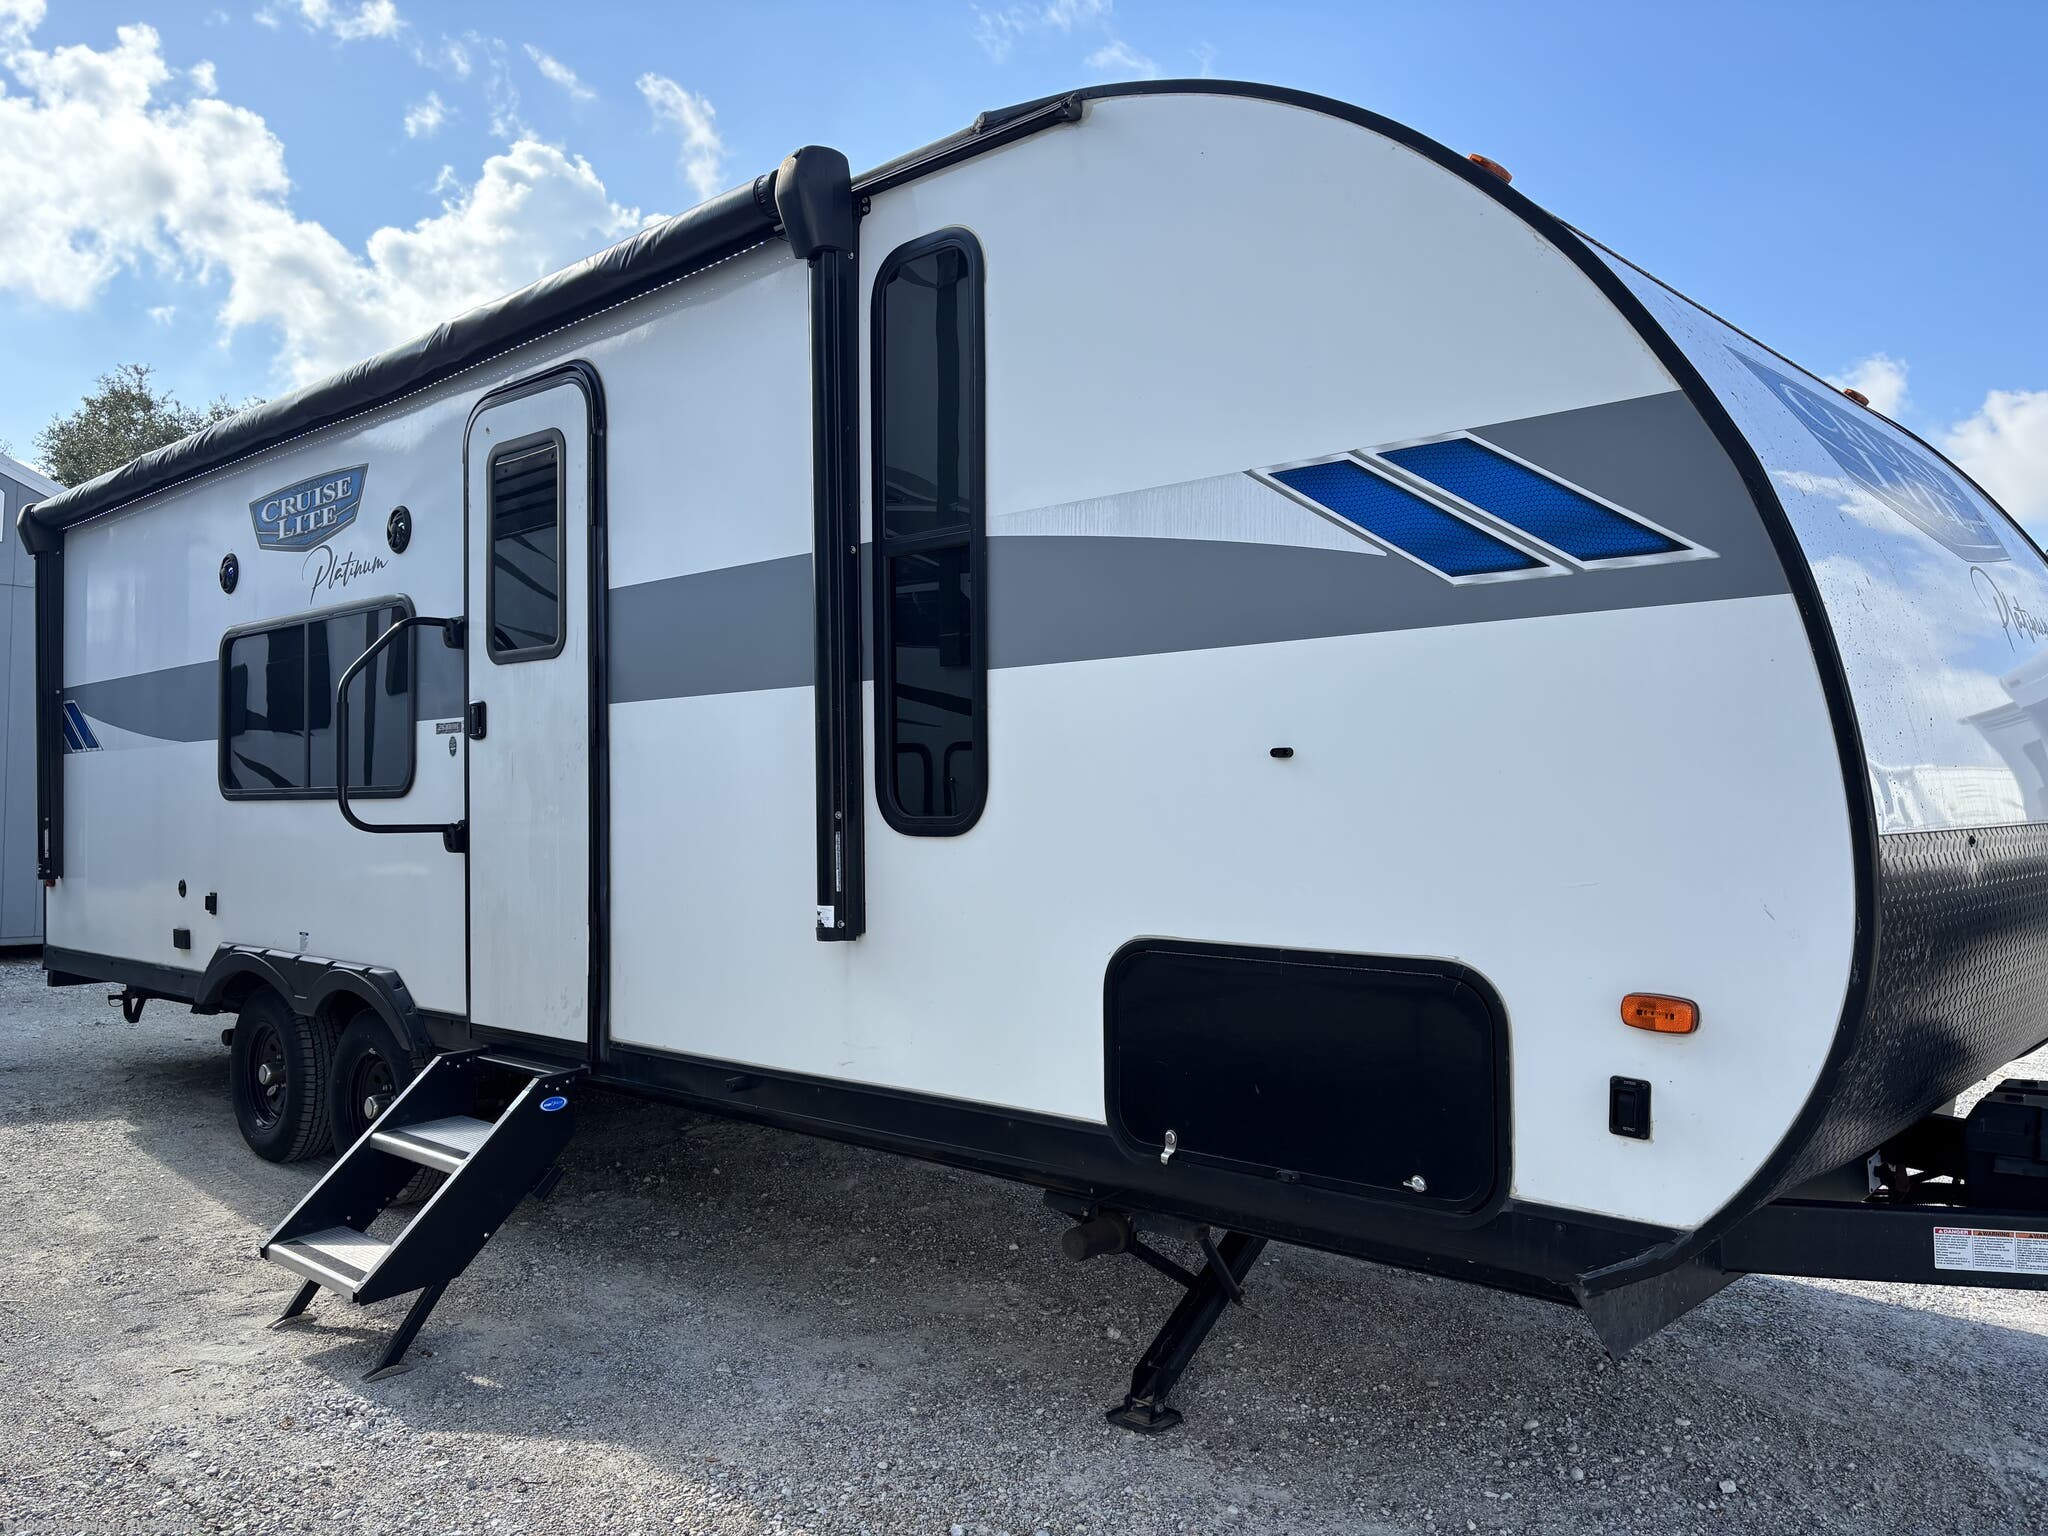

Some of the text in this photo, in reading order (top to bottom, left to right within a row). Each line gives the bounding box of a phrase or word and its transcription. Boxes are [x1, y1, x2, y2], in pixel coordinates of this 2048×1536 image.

[261, 476, 352, 523] CRUISE
[277, 504, 337, 541] LITE
[301, 544, 389, 605] Platinum
